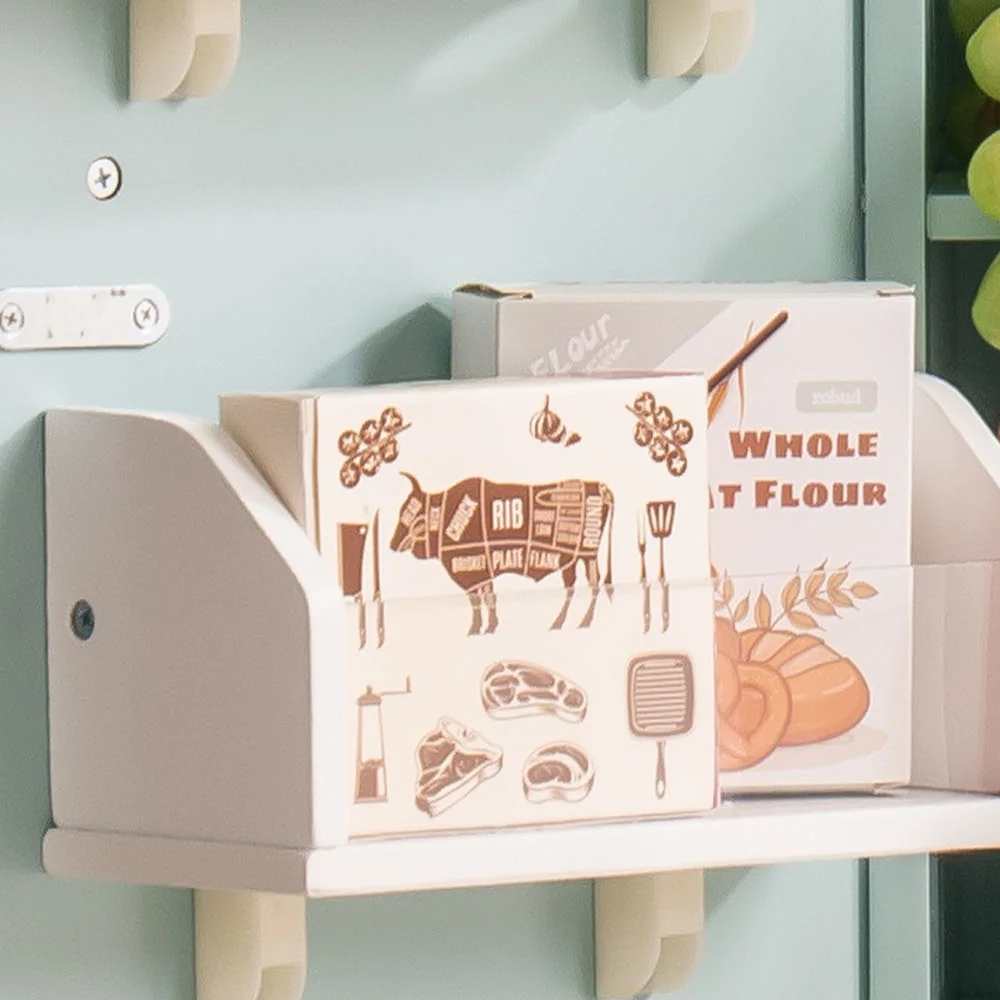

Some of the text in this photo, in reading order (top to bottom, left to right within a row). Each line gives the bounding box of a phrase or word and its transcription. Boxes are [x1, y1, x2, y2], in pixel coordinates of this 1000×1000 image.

[492, 498, 524, 531] RIB
[582, 495, 602, 549] ROUND
[492, 547, 524, 571] PLATE
[529, 549, 560, 571] FLANK
